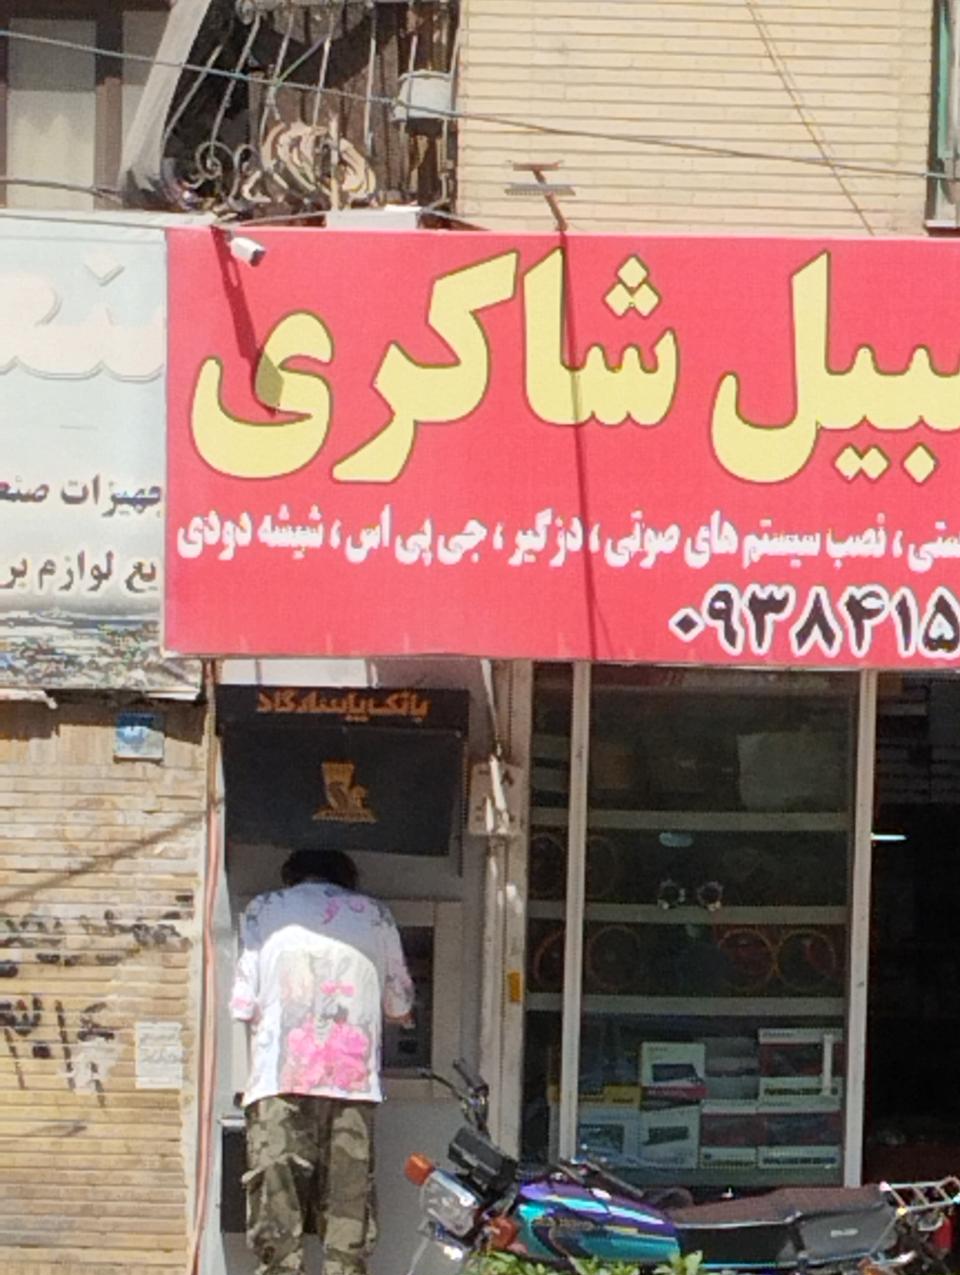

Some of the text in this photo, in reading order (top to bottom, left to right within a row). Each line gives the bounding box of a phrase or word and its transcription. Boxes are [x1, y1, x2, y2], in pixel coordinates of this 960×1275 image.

[190, 246, 680, 484] شاکری
[176, 510, 253, 561] دودی
[257, 503, 324, 560] شیشه
[394, 518, 432, 567] پی
[436, 519, 487, 566] جی
[683, 510, 738, 569] های
[742, 518, 821, 570] سیستم
[825, 512, 886, 569] نصب
